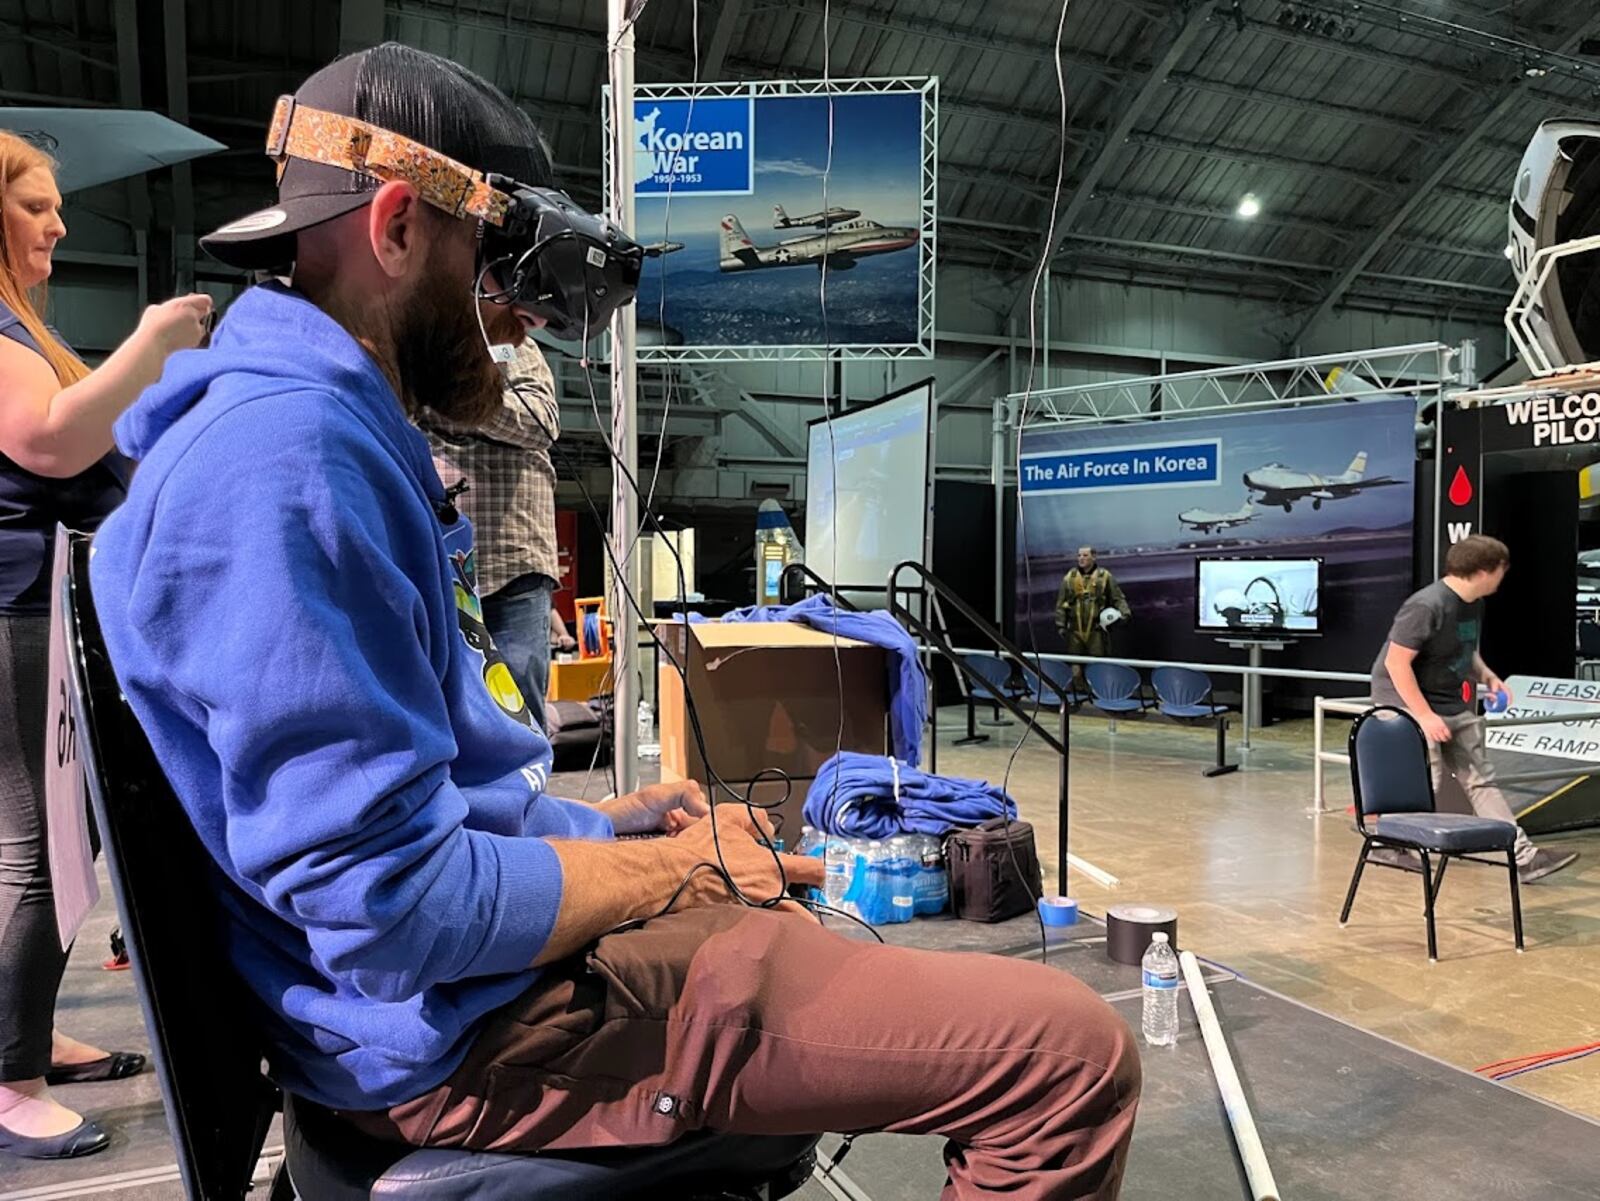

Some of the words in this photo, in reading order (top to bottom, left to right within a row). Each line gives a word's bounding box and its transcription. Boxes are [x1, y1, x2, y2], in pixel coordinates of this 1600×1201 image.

[647, 127, 743, 151] Korean
[652, 151, 699, 174] War
[654, 174, 702, 184] 1950-1953
[1025, 465, 1053, 482] The
[1056, 463, 1079, 479] Air
[1084, 461, 1129, 477] Force
[1133, 457, 1150, 474] In
[1154, 456, 1208, 473] Korea
[1487, 730, 1528, 746] THE
[1534, 736, 1599, 755] RAMP
